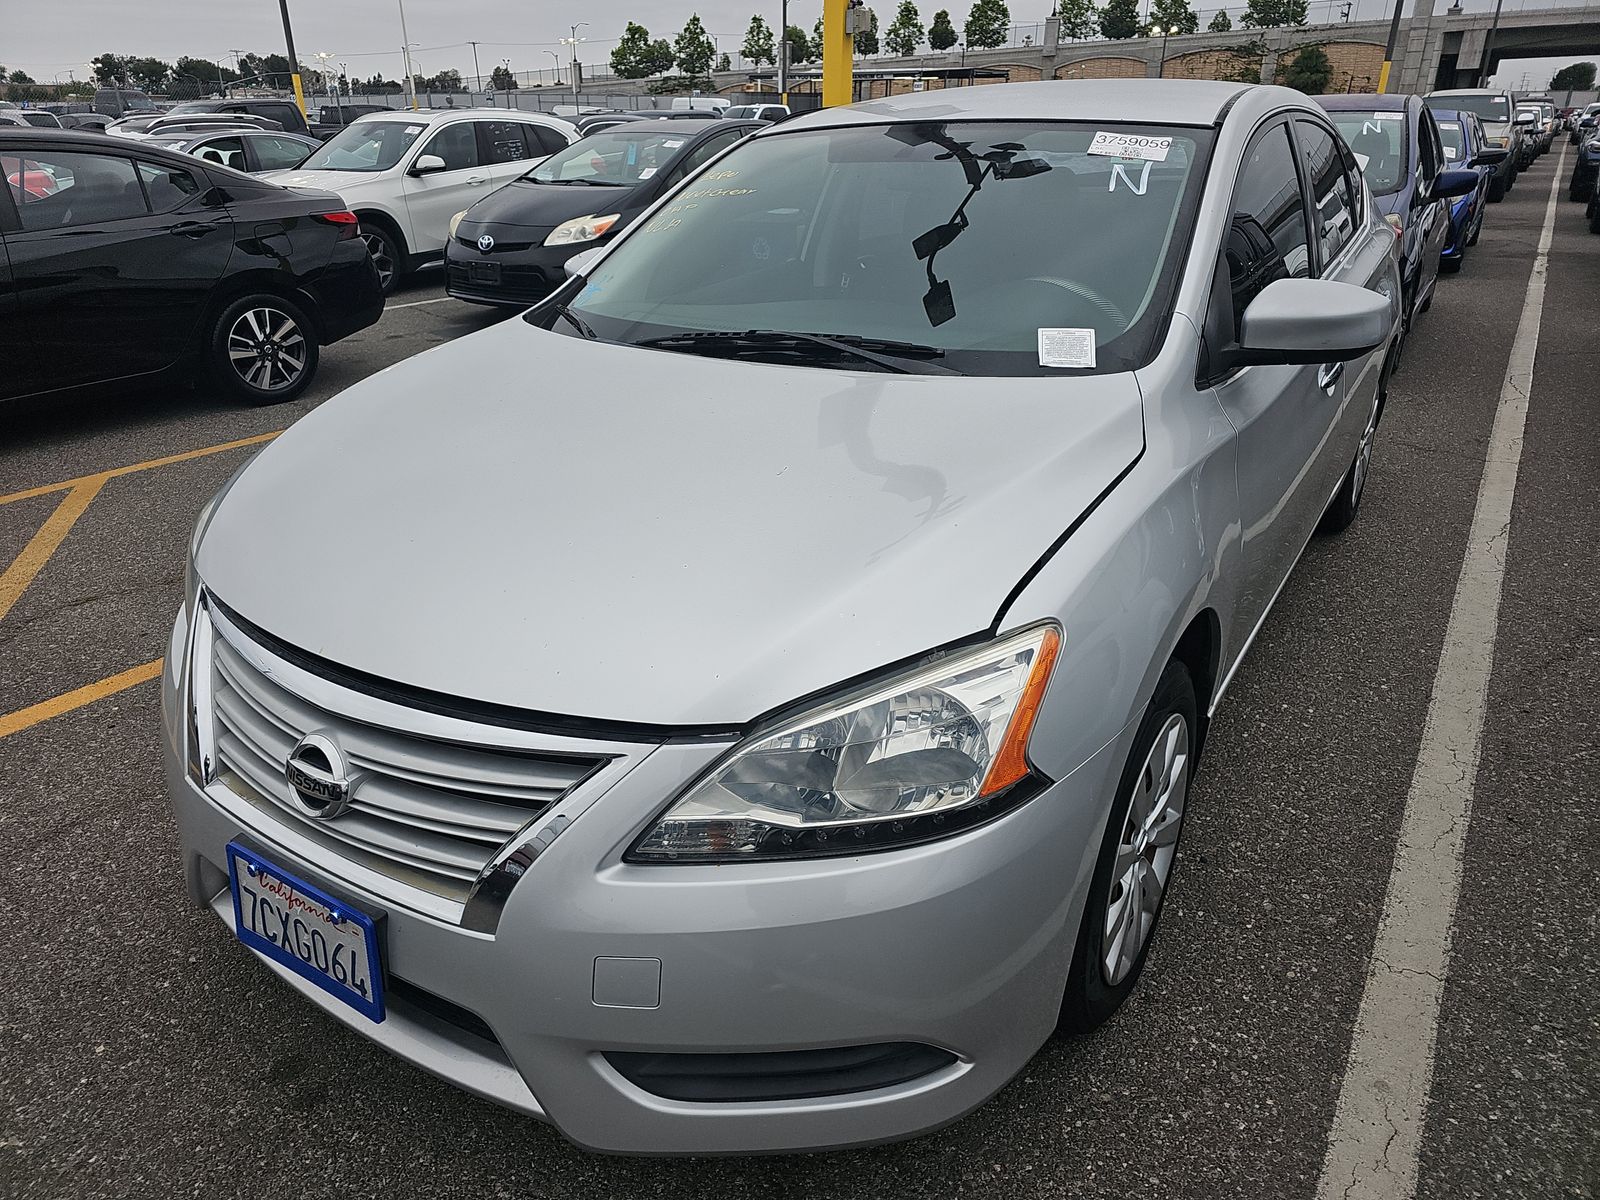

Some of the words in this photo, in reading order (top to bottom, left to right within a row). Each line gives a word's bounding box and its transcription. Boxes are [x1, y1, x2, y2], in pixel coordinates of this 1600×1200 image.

[1096, 134, 1171, 150] 3759059
[1108, 160, 1154, 196] N
[287, 767, 337, 797] NISSAN
[259, 871, 346, 934] California
[242, 884, 368, 998] 7CXG064
